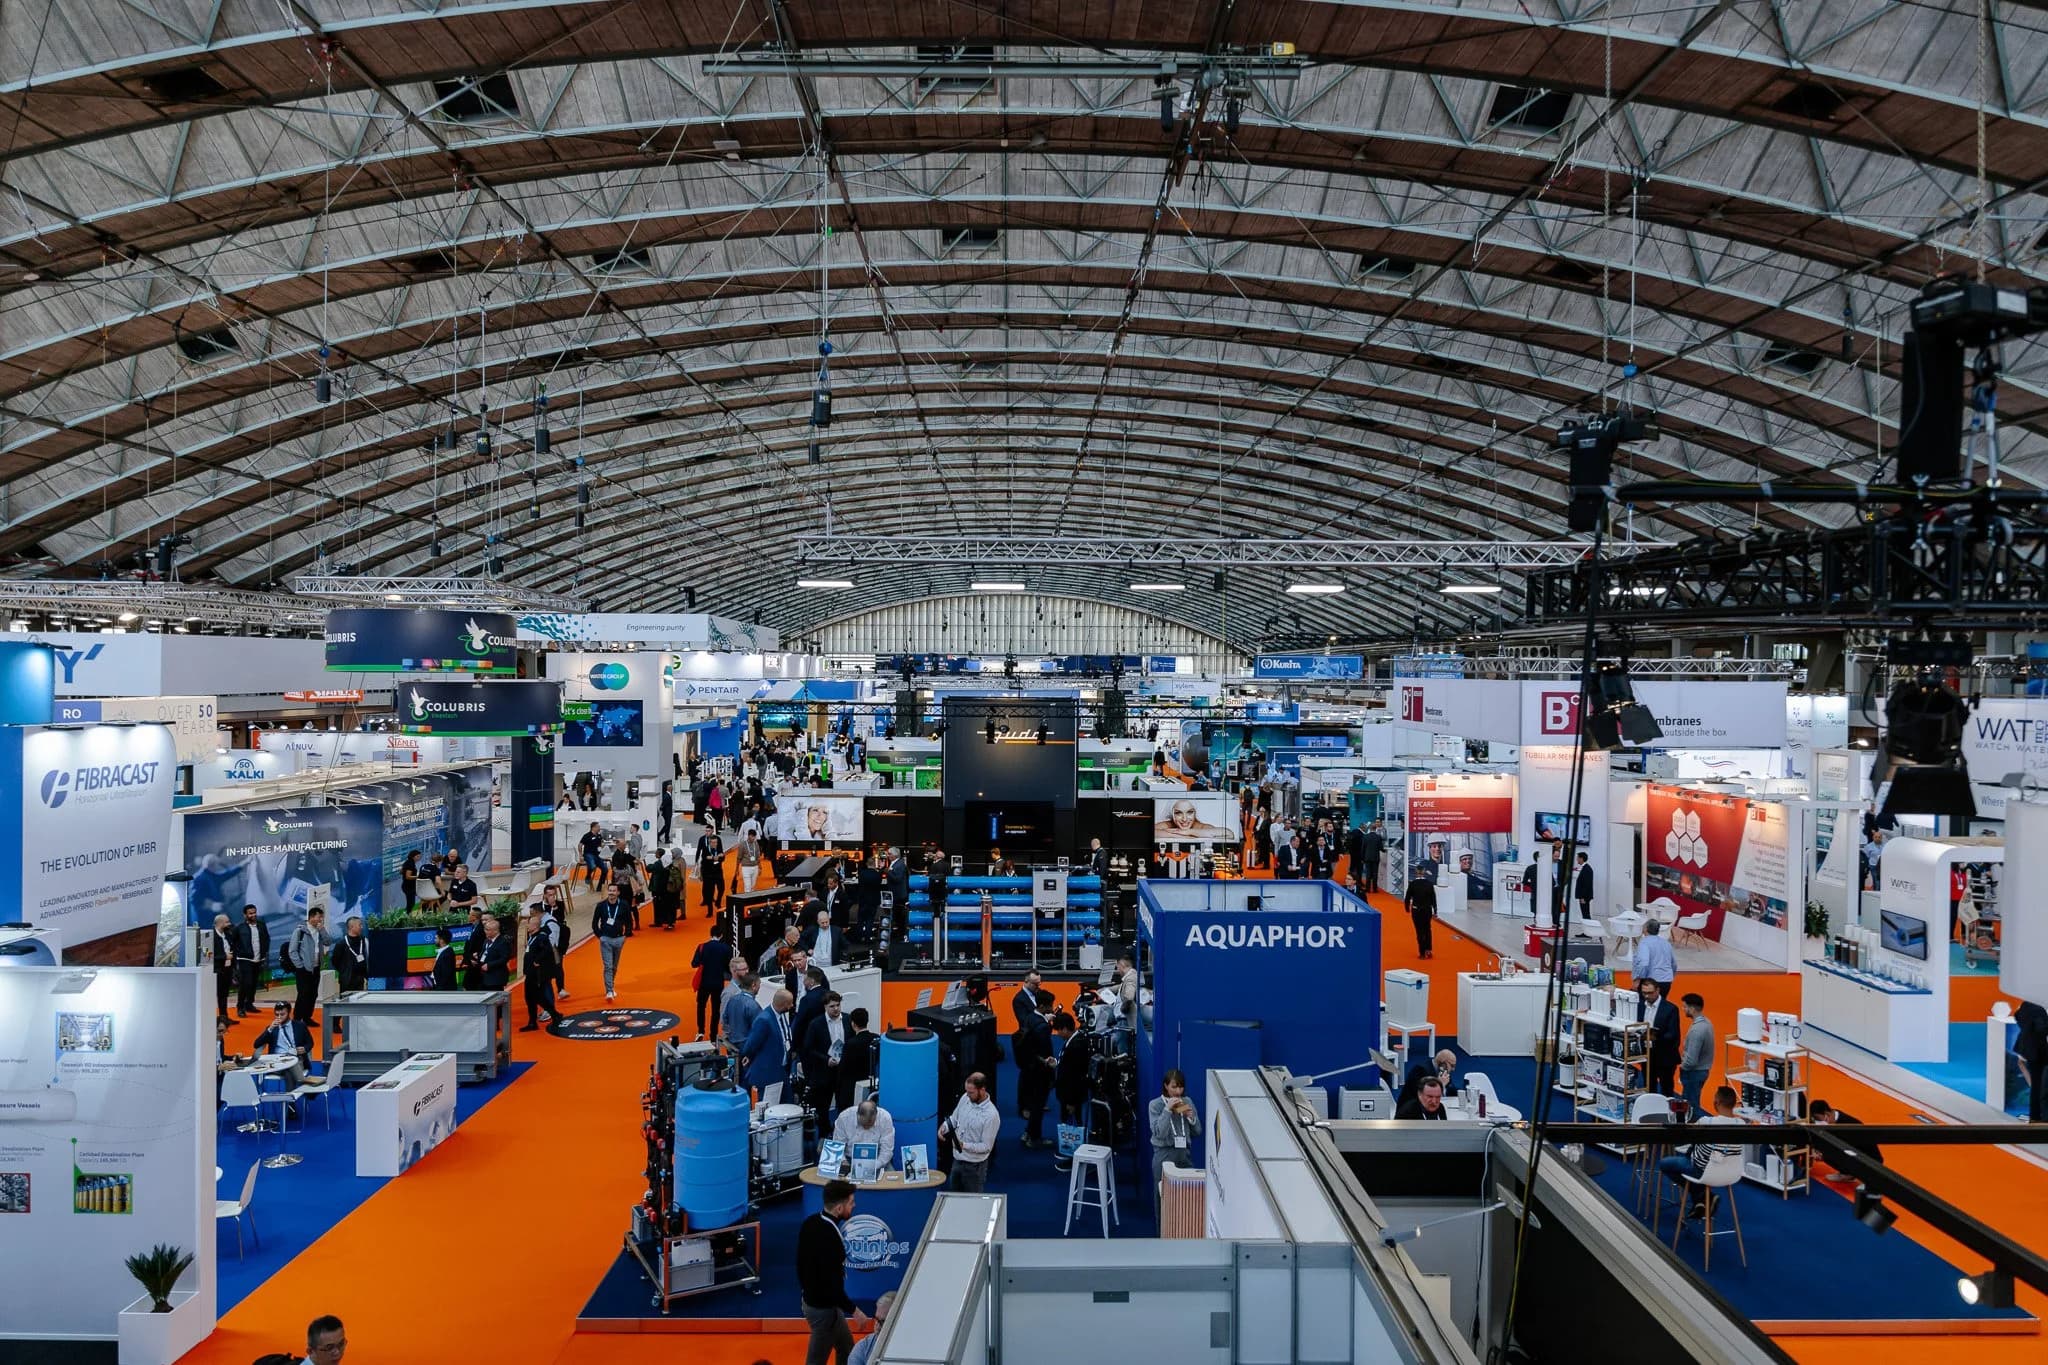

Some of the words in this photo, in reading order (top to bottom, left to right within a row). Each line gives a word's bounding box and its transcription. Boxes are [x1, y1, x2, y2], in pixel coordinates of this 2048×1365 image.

[626, 623, 664, 632] Engineering
[698, 686, 739, 694] PENTAIR
[158, 704, 192, 721] OVER
[199, 703, 213, 719] 50
[426, 702, 487, 713] COLUBRIS
[63, 708, 82, 720] RO
[1656, 716, 1702, 726] mbranes
[175, 719, 214, 736] YEARS
[1664, 728, 1695, 737] outside
[1696, 728, 1711, 737] the
[1712, 728, 1728, 738] box
[1975, 742, 2010, 752] WATCH
[2017, 743, 2048, 754] WATE
[74, 761, 160, 792] FIBRACAST
[225, 769, 265, 780] KALKI
[1981, 796, 2005, 808] Where
[279, 821, 313, 830] COLUBRIS
[226, 845, 272, 857] IN-HOUSE
[274, 840, 348, 853] MANUFACTURING
[40, 859, 62, 873] THE
[65, 848, 121, 869] EVOLUTION
[123, 846, 136, 858] OF
[138, 842, 157, 856] MBR
